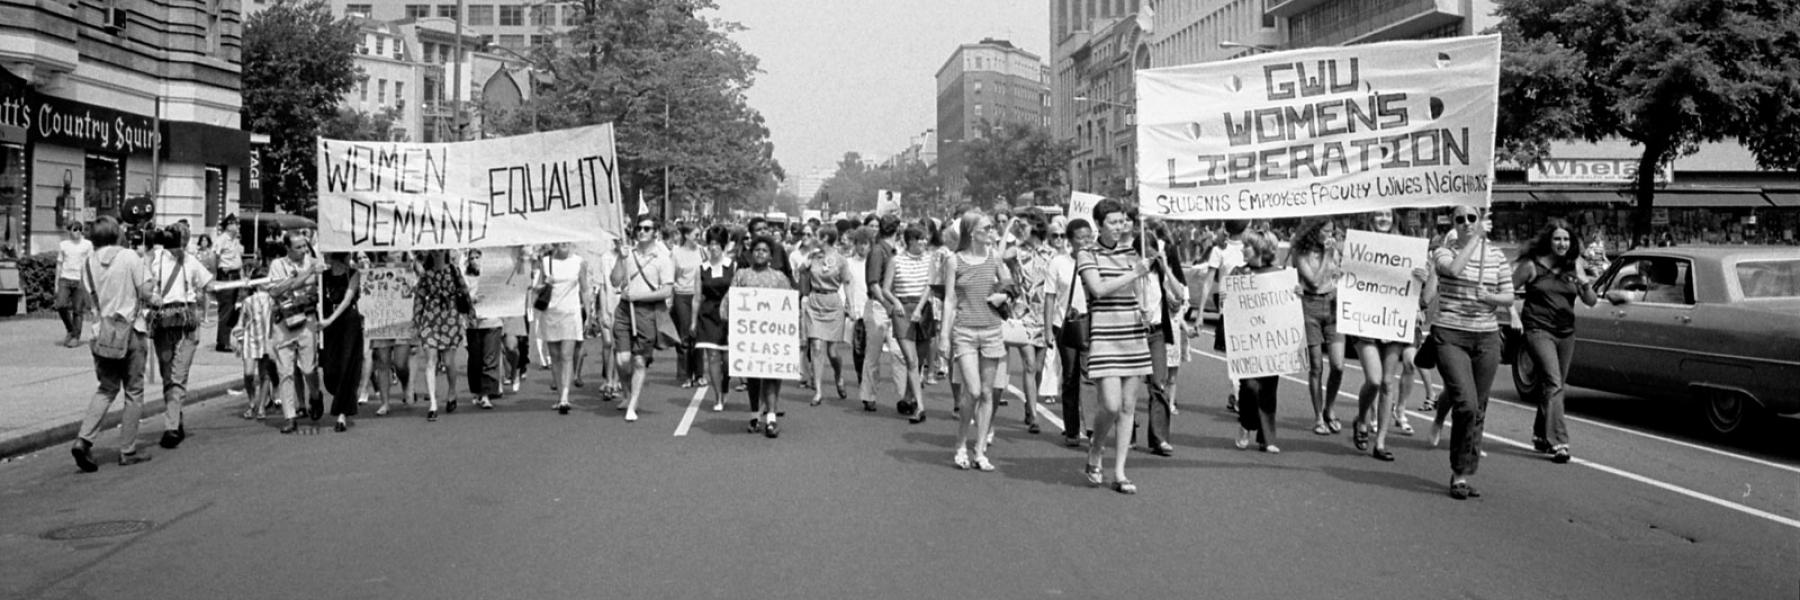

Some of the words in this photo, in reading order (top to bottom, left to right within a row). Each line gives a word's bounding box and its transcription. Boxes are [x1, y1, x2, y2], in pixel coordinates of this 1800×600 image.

[1263, 57, 1359, 101] GWU
[0, 97, 31, 129] tt's
[38, 103, 109, 148] Country
[1223, 91, 1408, 146] WOMEN'S
[324, 141, 447, 194] WOMEN
[1167, 127, 1469, 188] LIBERATION
[1540, 160, 1639, 176] Whela
[488, 155, 615, 220] EQUALITY
[1238, 189, 1308, 212] EMPLOYEES
[1310, 183, 1371, 208] FACULTY
[1073, 200, 1089, 214] Wo
[350, 198, 489, 246] DEMAND
[1349, 242, 1412, 268] Women
[1224, 275, 1258, 292] FREE
[1344, 271, 1411, 297] Demand
[781, 295, 792, 311] A
[1238, 289, 1295, 309] ABORTION
[737, 319, 797, 336] SECOND
[1249, 315, 1266, 327] ON
[1342, 301, 1408, 338] Equality
[737, 341, 791, 356] CLASS
[1229, 327, 1301, 352] DEMAND
[733, 358, 799, 374] CITIZEN
